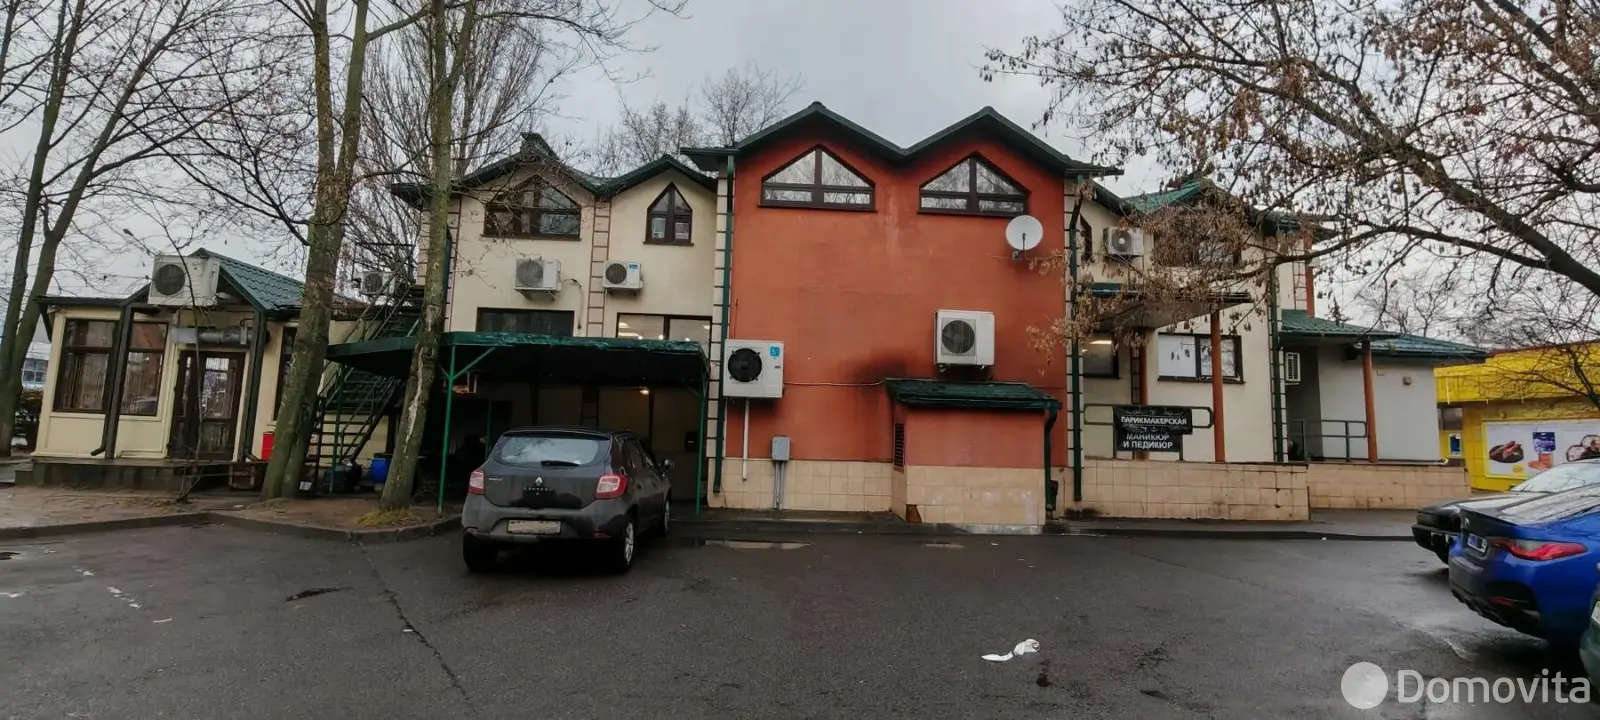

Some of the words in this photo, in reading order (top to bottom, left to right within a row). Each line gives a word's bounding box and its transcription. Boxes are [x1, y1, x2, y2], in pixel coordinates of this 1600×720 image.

[1121, 416, 1187, 425] ПАРИКМАХЕРСКАЯ
[1126, 433, 1170, 441] МАНИКЮР
[1132, 441, 1173, 449] ПЕДИКЮР
